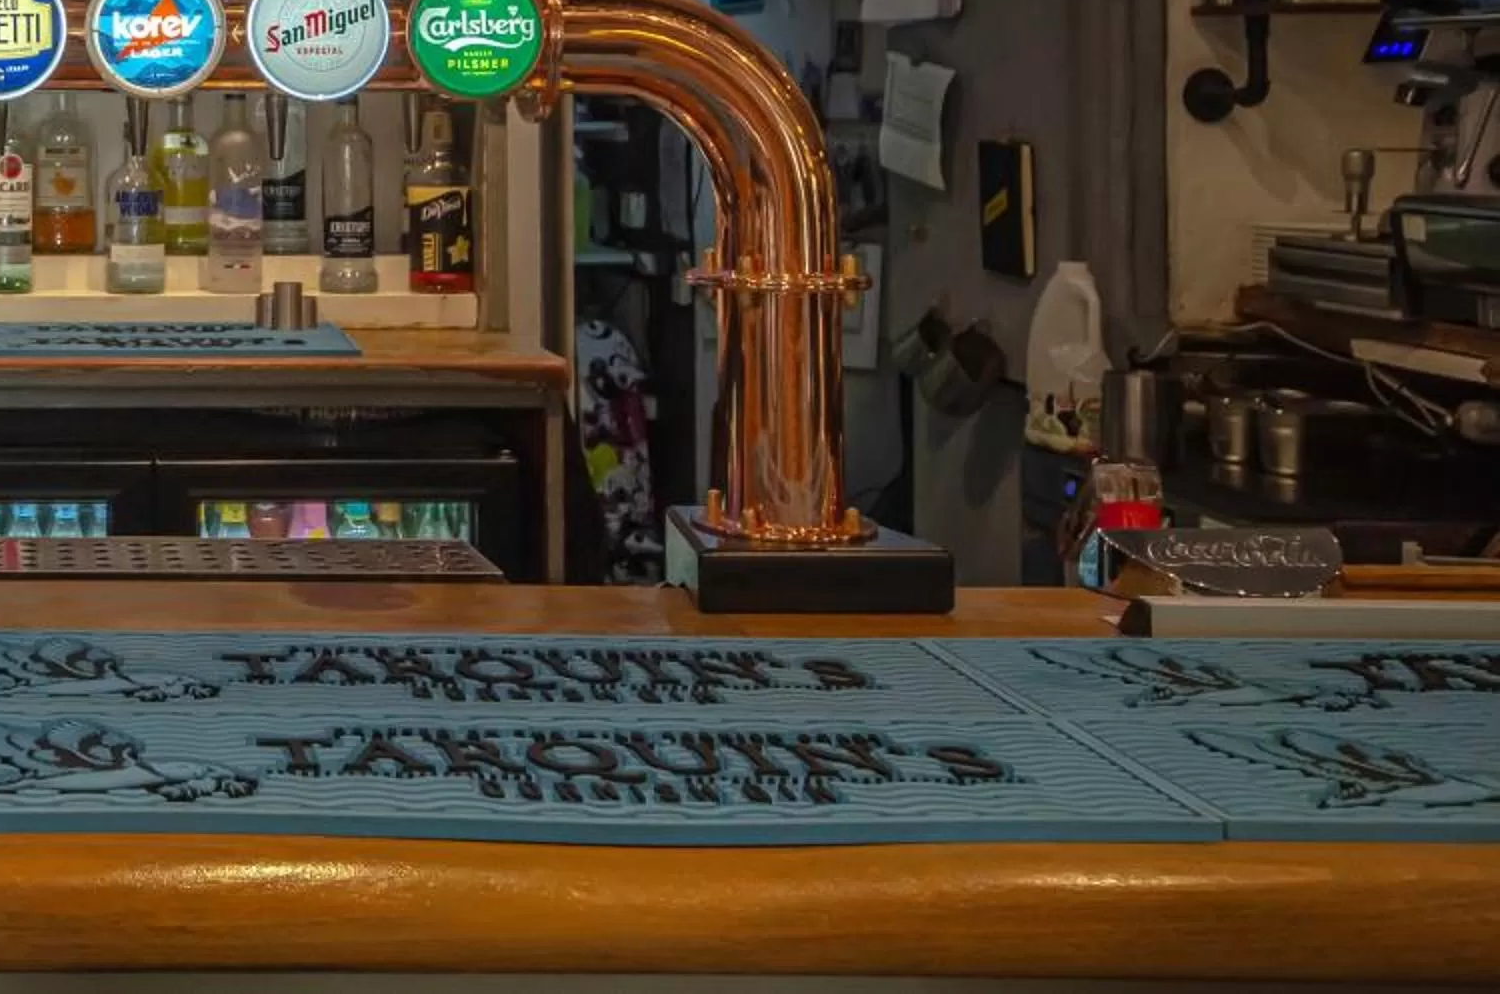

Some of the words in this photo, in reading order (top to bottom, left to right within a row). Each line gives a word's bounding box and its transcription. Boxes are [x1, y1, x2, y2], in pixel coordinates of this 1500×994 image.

[112, 10, 203, 40] korev
[419, 5, 535, 52] Carlsberg
[131, 47, 184, 59] LAGER
[447, 58, 509, 70] PILSNER
